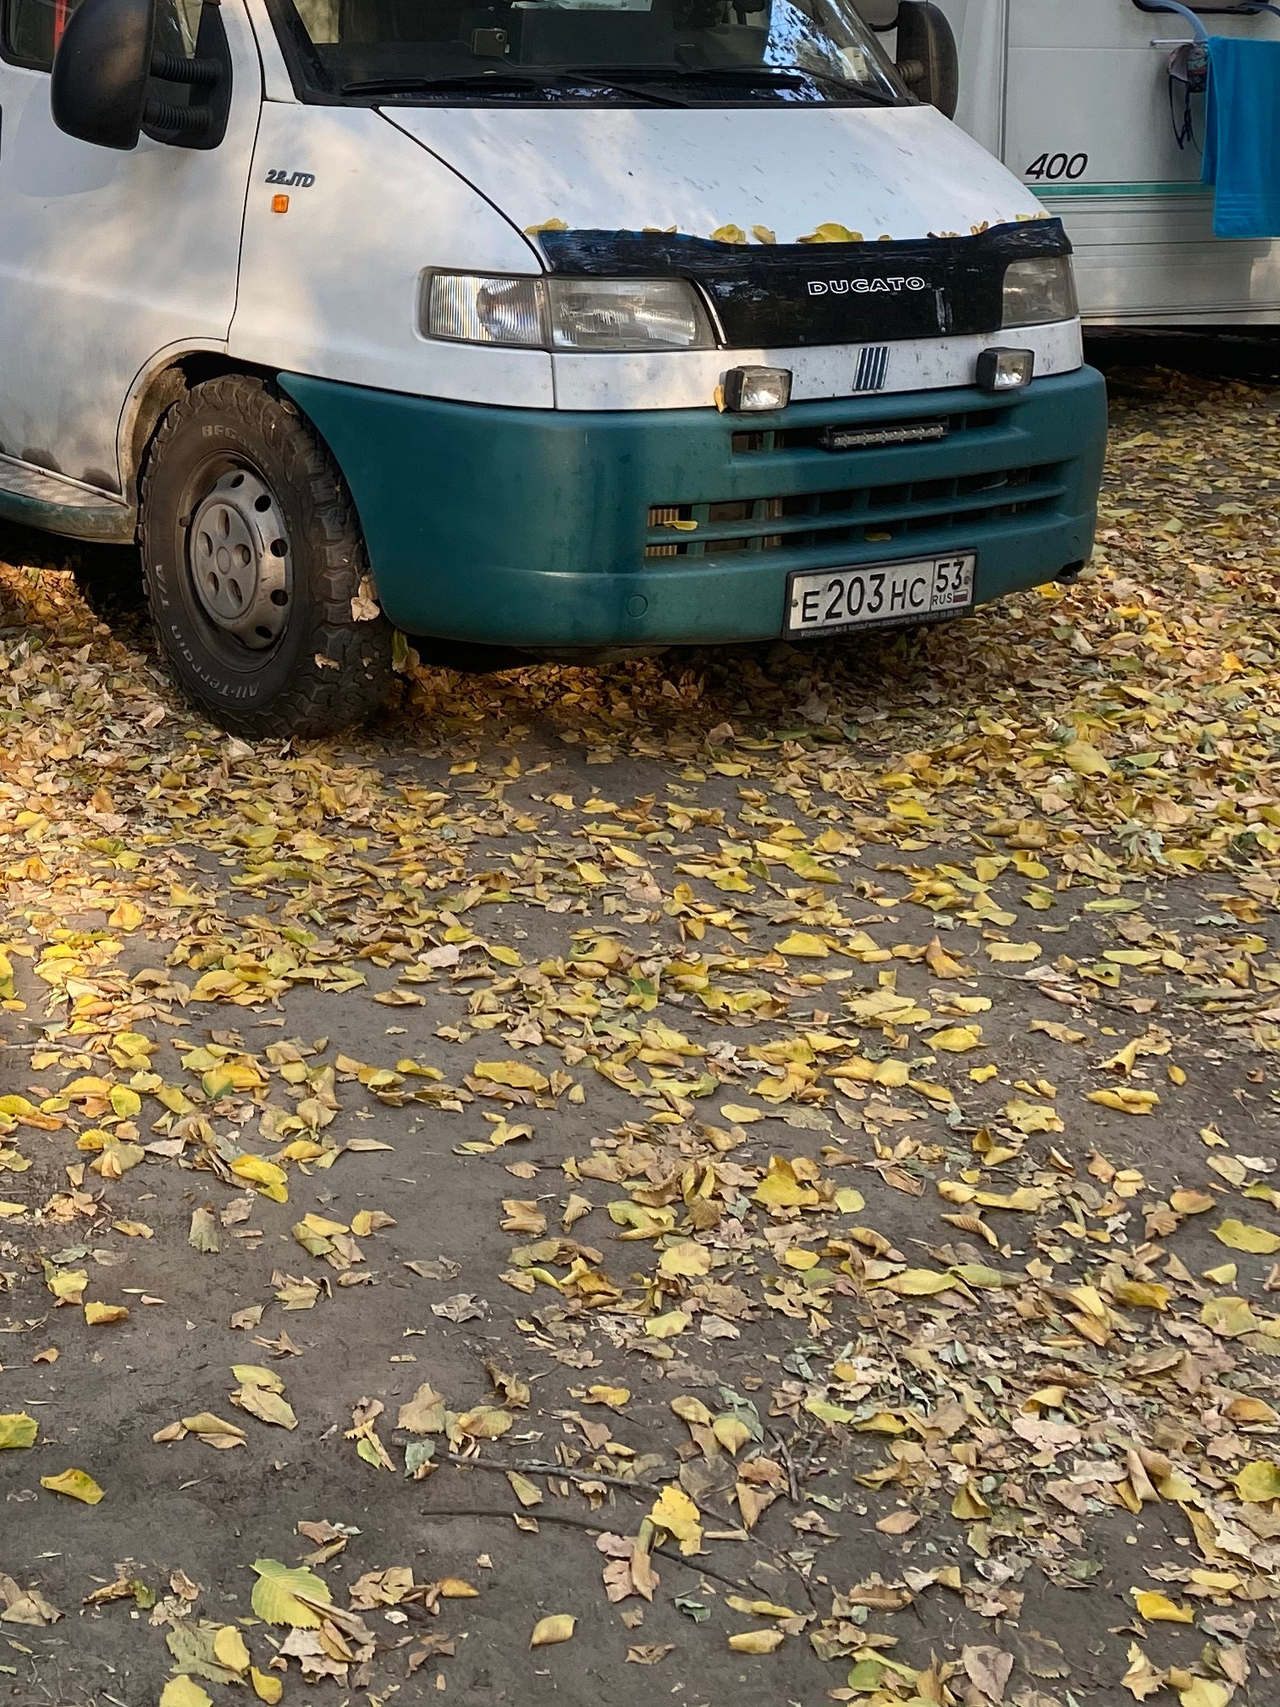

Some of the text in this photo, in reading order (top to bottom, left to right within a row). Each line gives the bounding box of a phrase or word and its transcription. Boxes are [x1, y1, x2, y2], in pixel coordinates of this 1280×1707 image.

[1024, 152, 1089, 180] 400
[807, 276, 926, 296] DUCATO
[935, 560, 966, 593] 53
[932, 593, 953, 606] RUS
